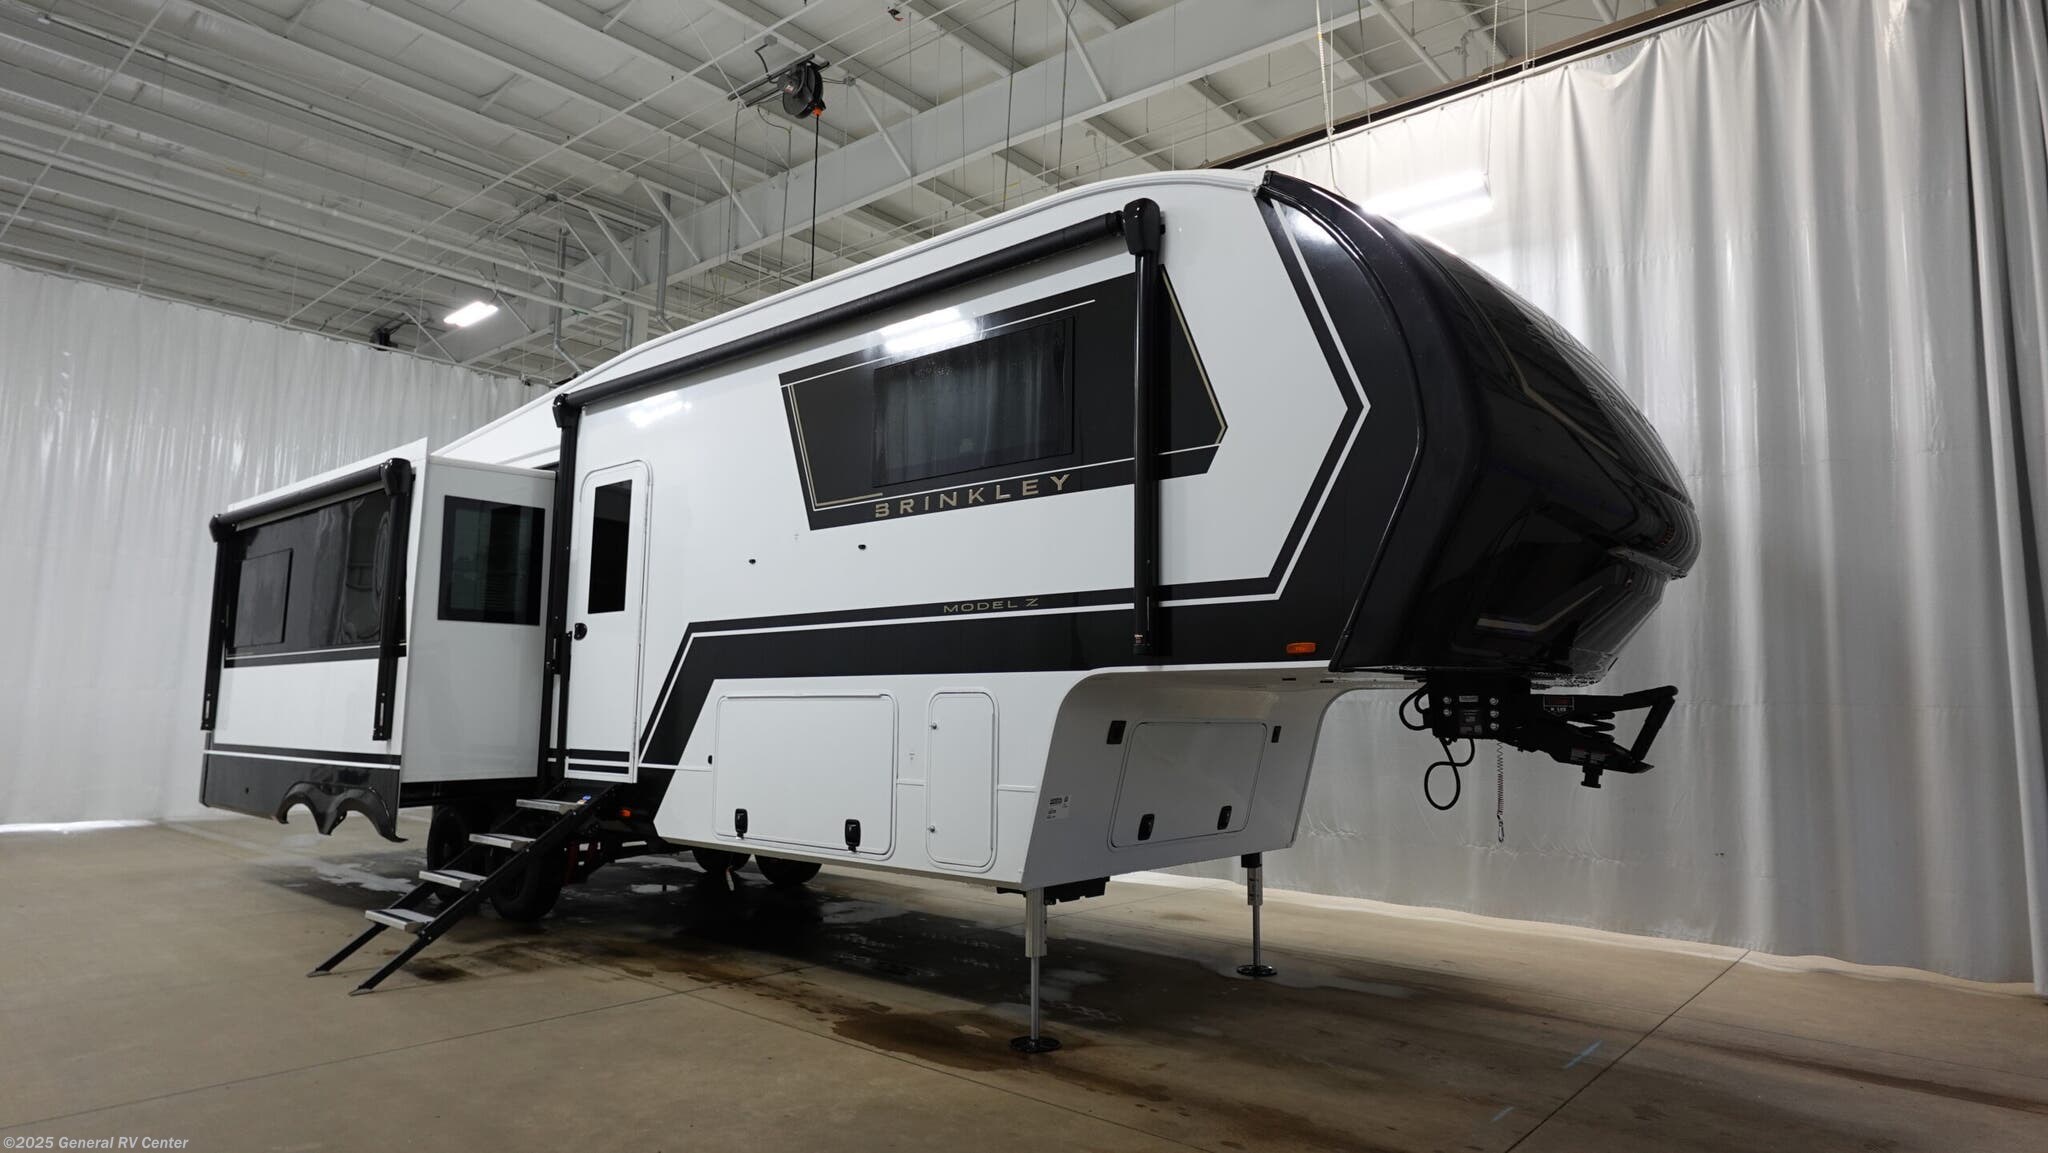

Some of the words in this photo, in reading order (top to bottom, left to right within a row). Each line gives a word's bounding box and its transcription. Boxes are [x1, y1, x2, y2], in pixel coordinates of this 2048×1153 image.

[874, 473, 1071, 518] BRINKLEY
[943, 600, 1018, 613] MODEL
[1024, 598, 1039, 607] Z
